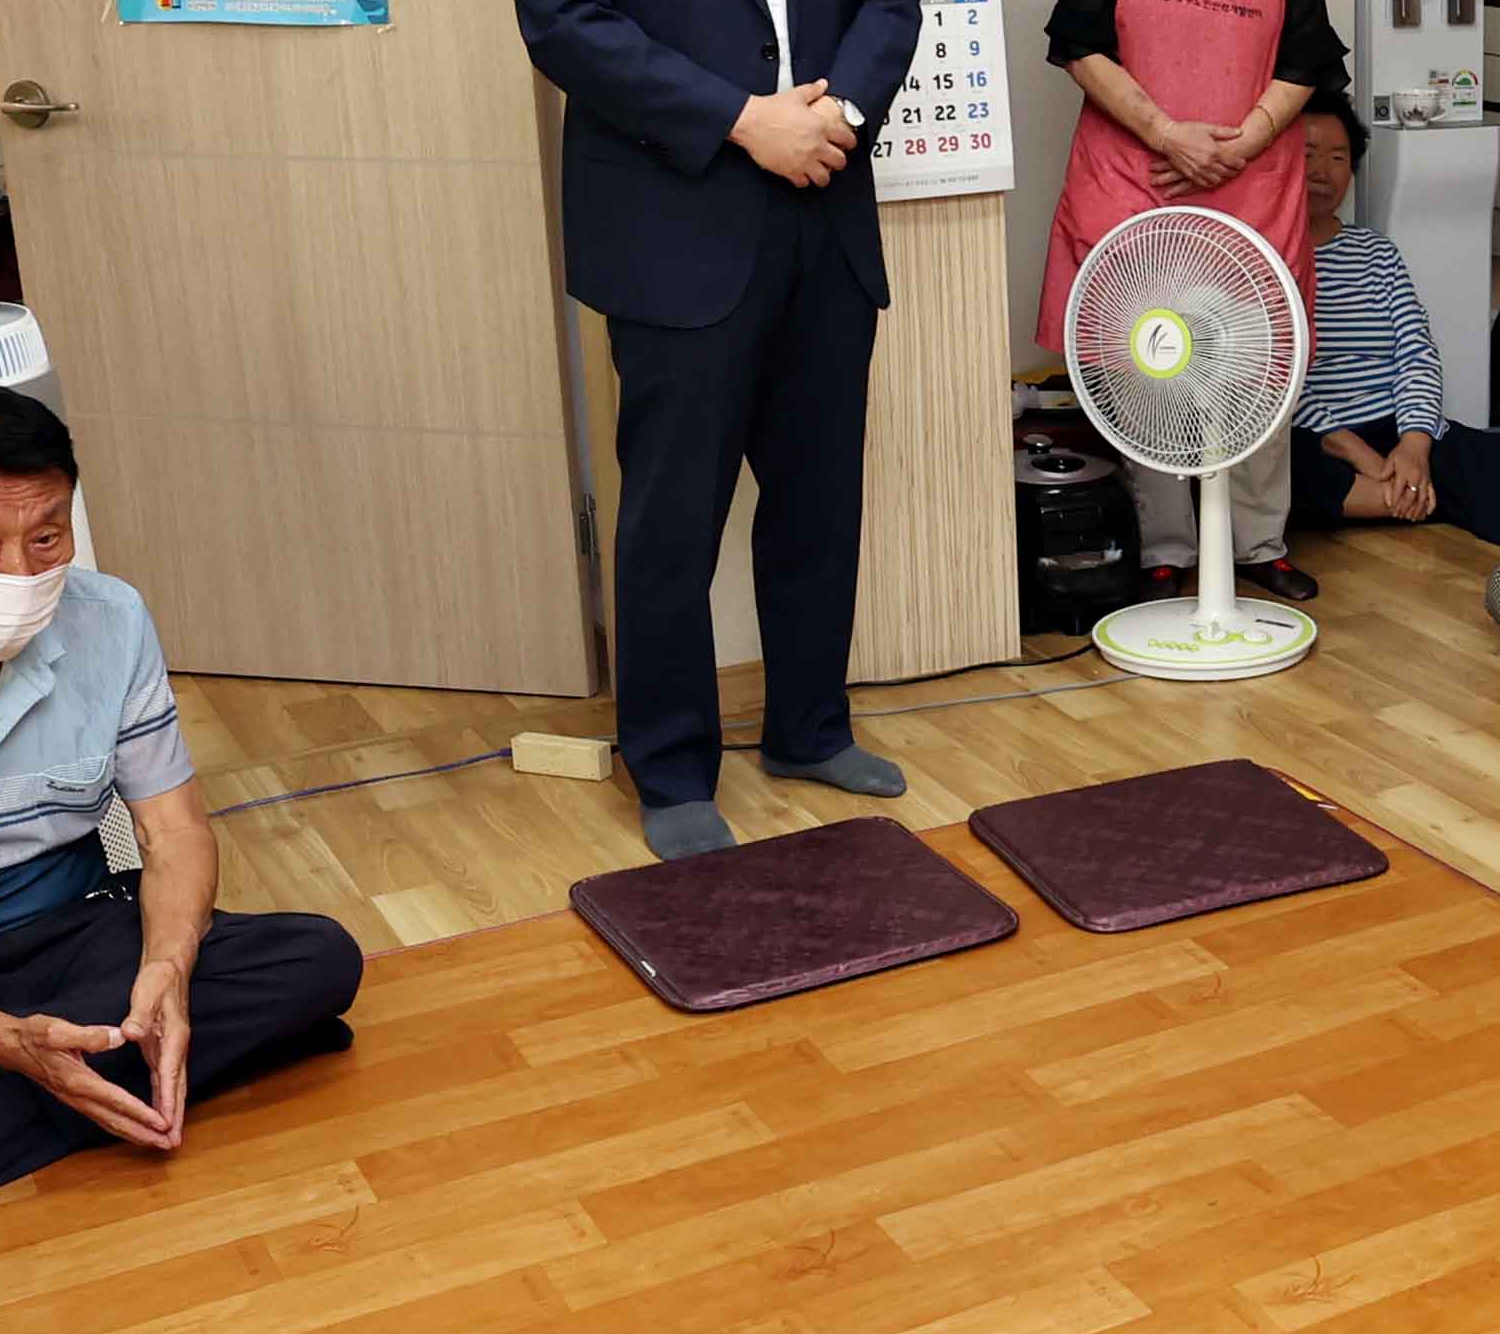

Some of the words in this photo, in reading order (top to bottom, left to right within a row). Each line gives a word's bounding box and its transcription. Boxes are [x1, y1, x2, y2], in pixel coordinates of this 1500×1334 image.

[934, 10, 943, 27] 1
[967, 9, 978, 25] 2
[935, 42, 947, 59] 8
[969, 40, 980, 57] 9
[901, 76, 921, 92] 14
[932, 73, 954, 90] 15
[966, 71, 987, 88] 16
[901, 106, 922, 124] 21
[934, 104, 957, 122] 22
[967, 102, 989, 119] 23
[873, 141, 893, 158] 27
[904, 138, 927, 156] 28
[937, 135, 959, 153] 29
[970, 132, 991, 150] 30
